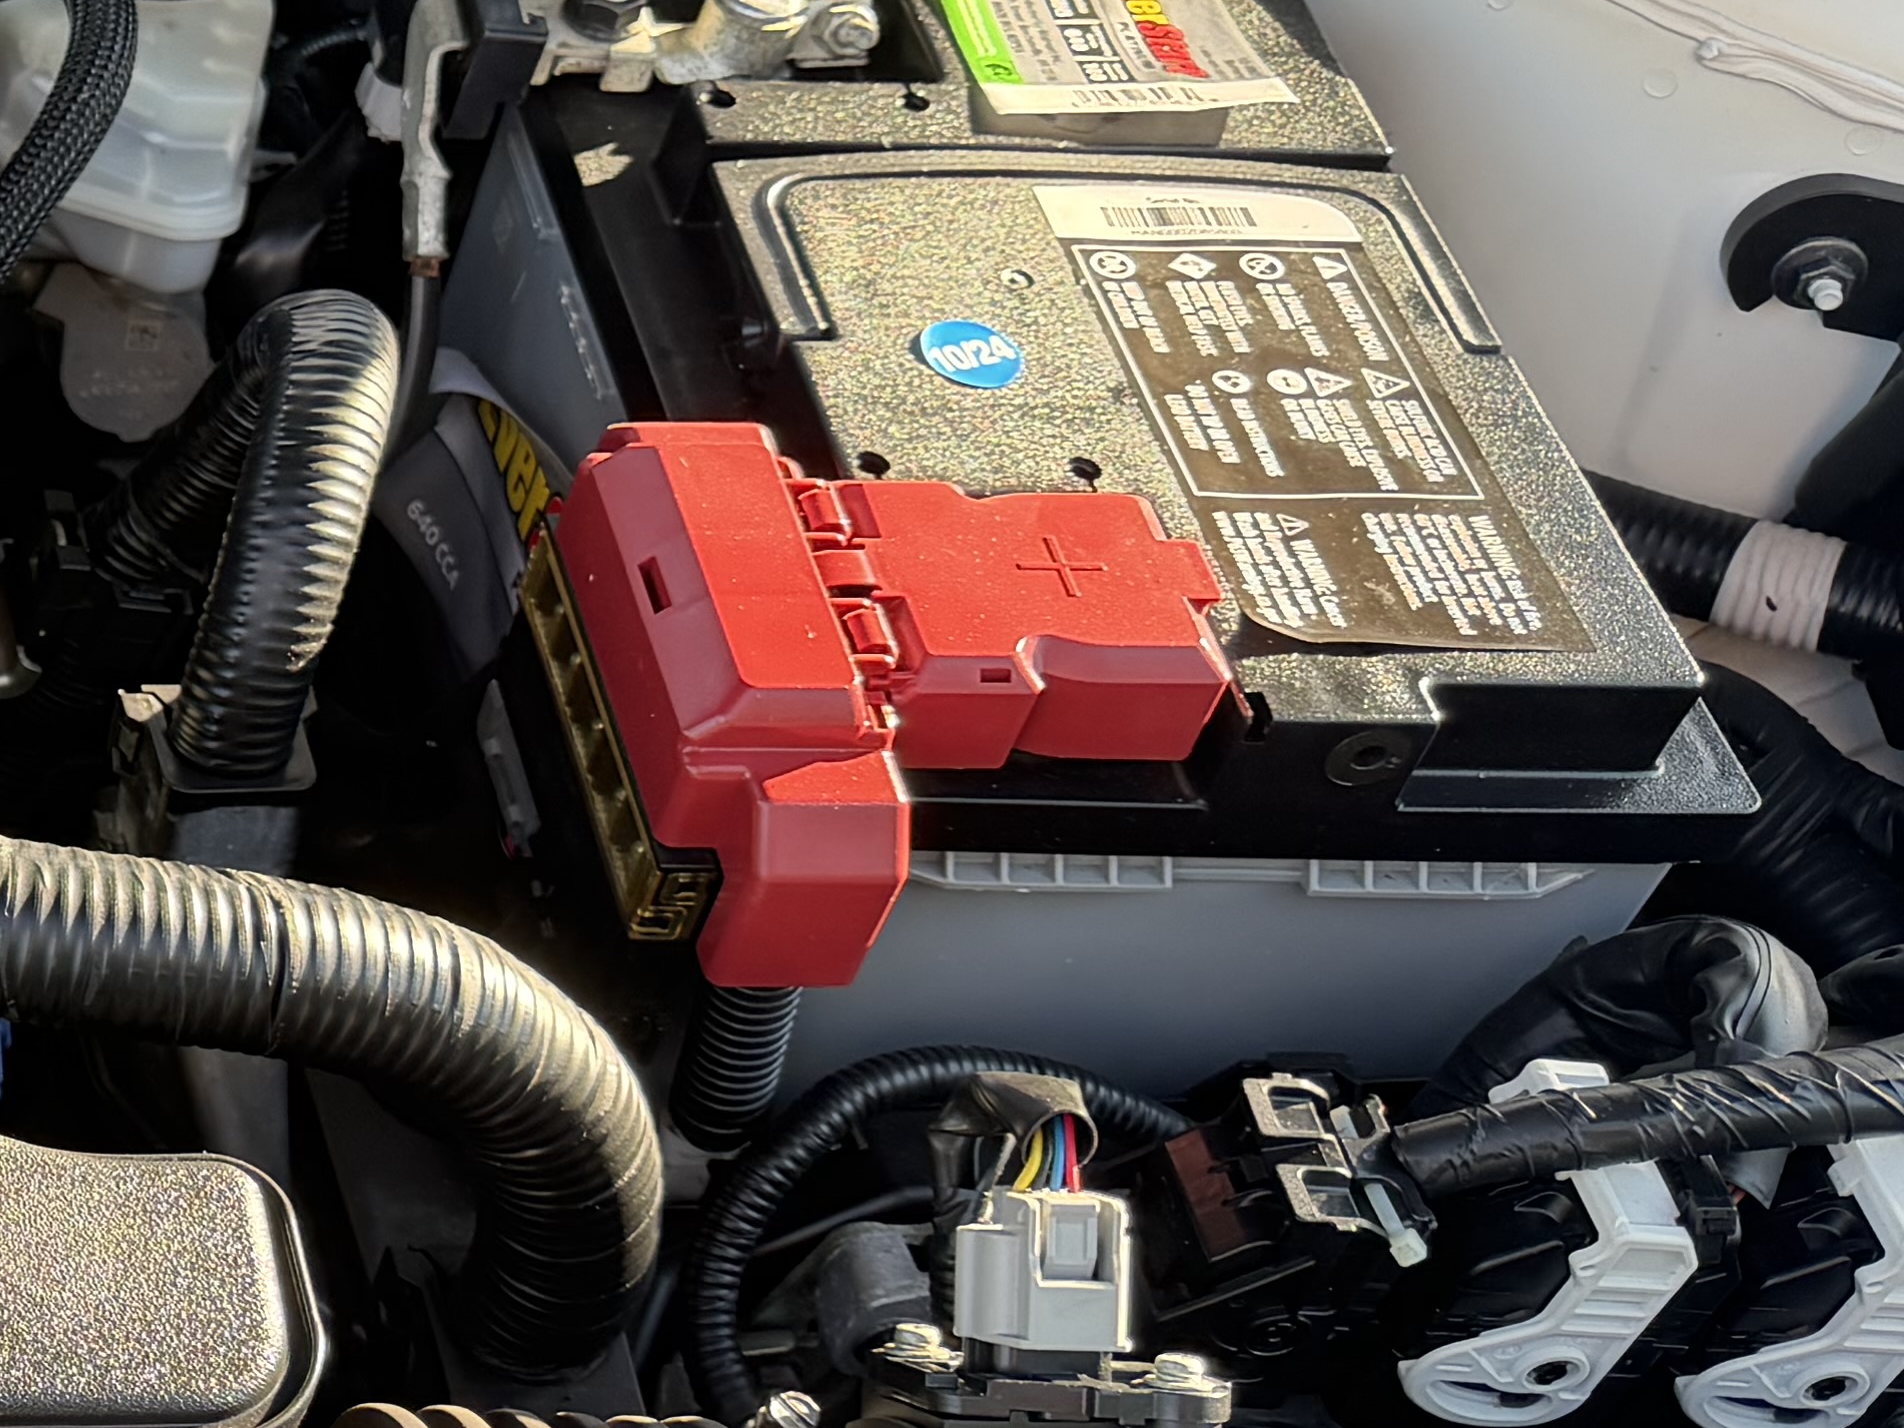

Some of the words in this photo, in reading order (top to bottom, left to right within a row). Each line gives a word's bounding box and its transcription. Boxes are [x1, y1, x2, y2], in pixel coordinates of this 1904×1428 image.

[1327, 281, 1388, 361] DANGER/POISON
[928, 335, 1016, 373] 10/24
[407, 499, 440, 546] 640
[434, 542, 459, 590] CCA
[1469, 515, 1520, 579] WARNING:
[1516, 599, 1537, 612] of
[1290, 539, 1337, 595] WARNING:
[1319, 595, 1347, 628] Cancer
[1403, 565, 1439, 603] product
[1498, 602, 1516, 617] Do
[1506, 616, 1528, 635] not
